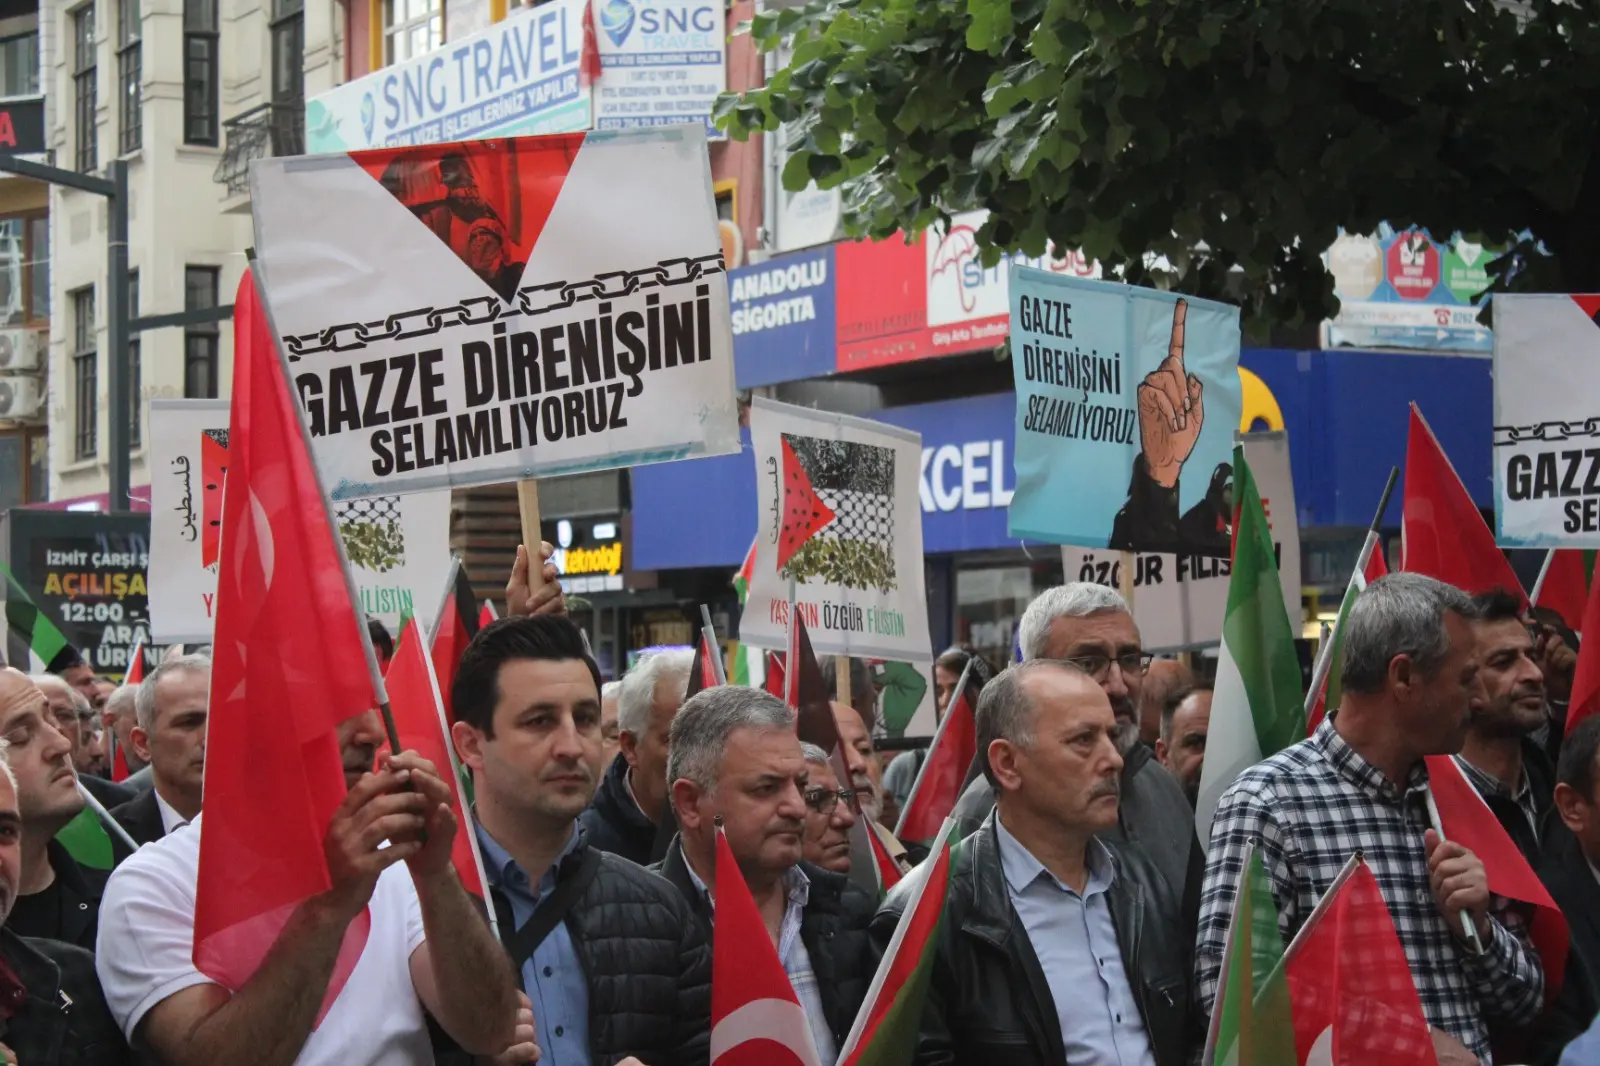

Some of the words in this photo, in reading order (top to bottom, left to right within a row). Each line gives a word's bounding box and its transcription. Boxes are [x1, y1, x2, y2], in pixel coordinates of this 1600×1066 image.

[640, 7, 714, 34] SNG
[641, 33, 714, 49] TRAVEL
[384, 56, 446, 129] SNG
[453, 7, 579, 103] TRAVEL
[528, 74, 578, 104] YAPILIR
[731, 259, 826, 303] ANADOLU
[732, 295, 815, 335] SİGORTA
[1020, 294, 1073, 339] GAZZE
[295, 348, 447, 437] GAZZE
[461, 284, 712, 409] DİRENİŞİNİ
[1023, 339, 1121, 403] DİRENİŞİNİ
[370, 382, 627, 477] SELAMLIYORUZ
[1024, 394, 1136, 445] SELAMLIYORUZ
[171, 455, 197, 542] فلسطين
[46, 549, 88, 566] İZMİT
[91, 552, 135, 569] ÇARŞI
[60, 602, 124, 622] 12:00
[770, 598, 819, 633] YAŞSIN
[823, 600, 863, 633] ÖZGÜR
[867, 605, 905, 637] FİLİSTİN
